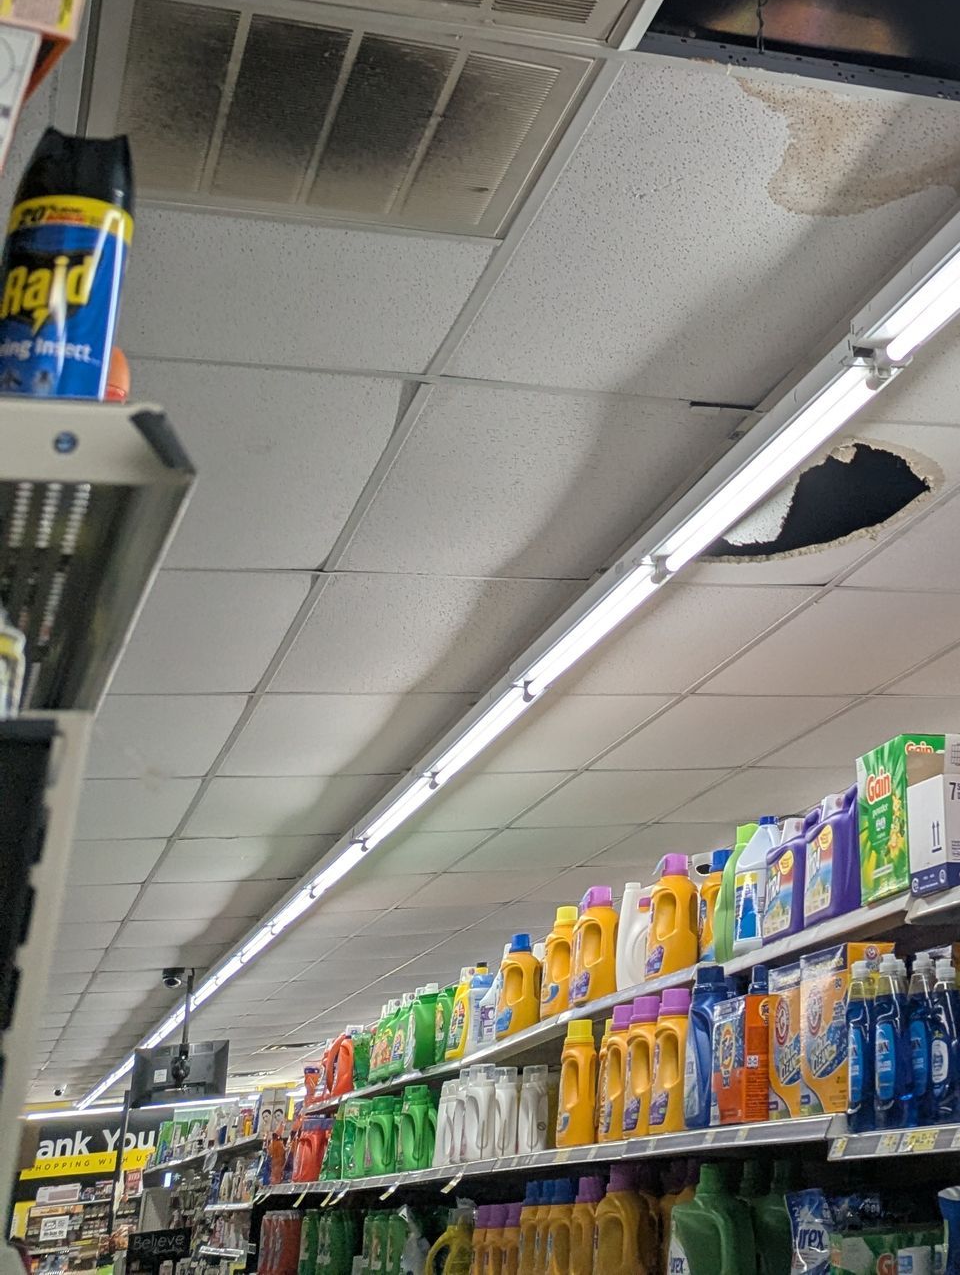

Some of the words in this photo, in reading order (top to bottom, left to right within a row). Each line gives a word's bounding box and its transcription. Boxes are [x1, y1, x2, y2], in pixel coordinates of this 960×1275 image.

[0, 255, 95, 319] Raid
[866, 767, 893, 805] Gain
[949, 782, 957, 801] 7
[102, 1128, 156, 1153] You
[133, 1235, 185, 1251] Believe
